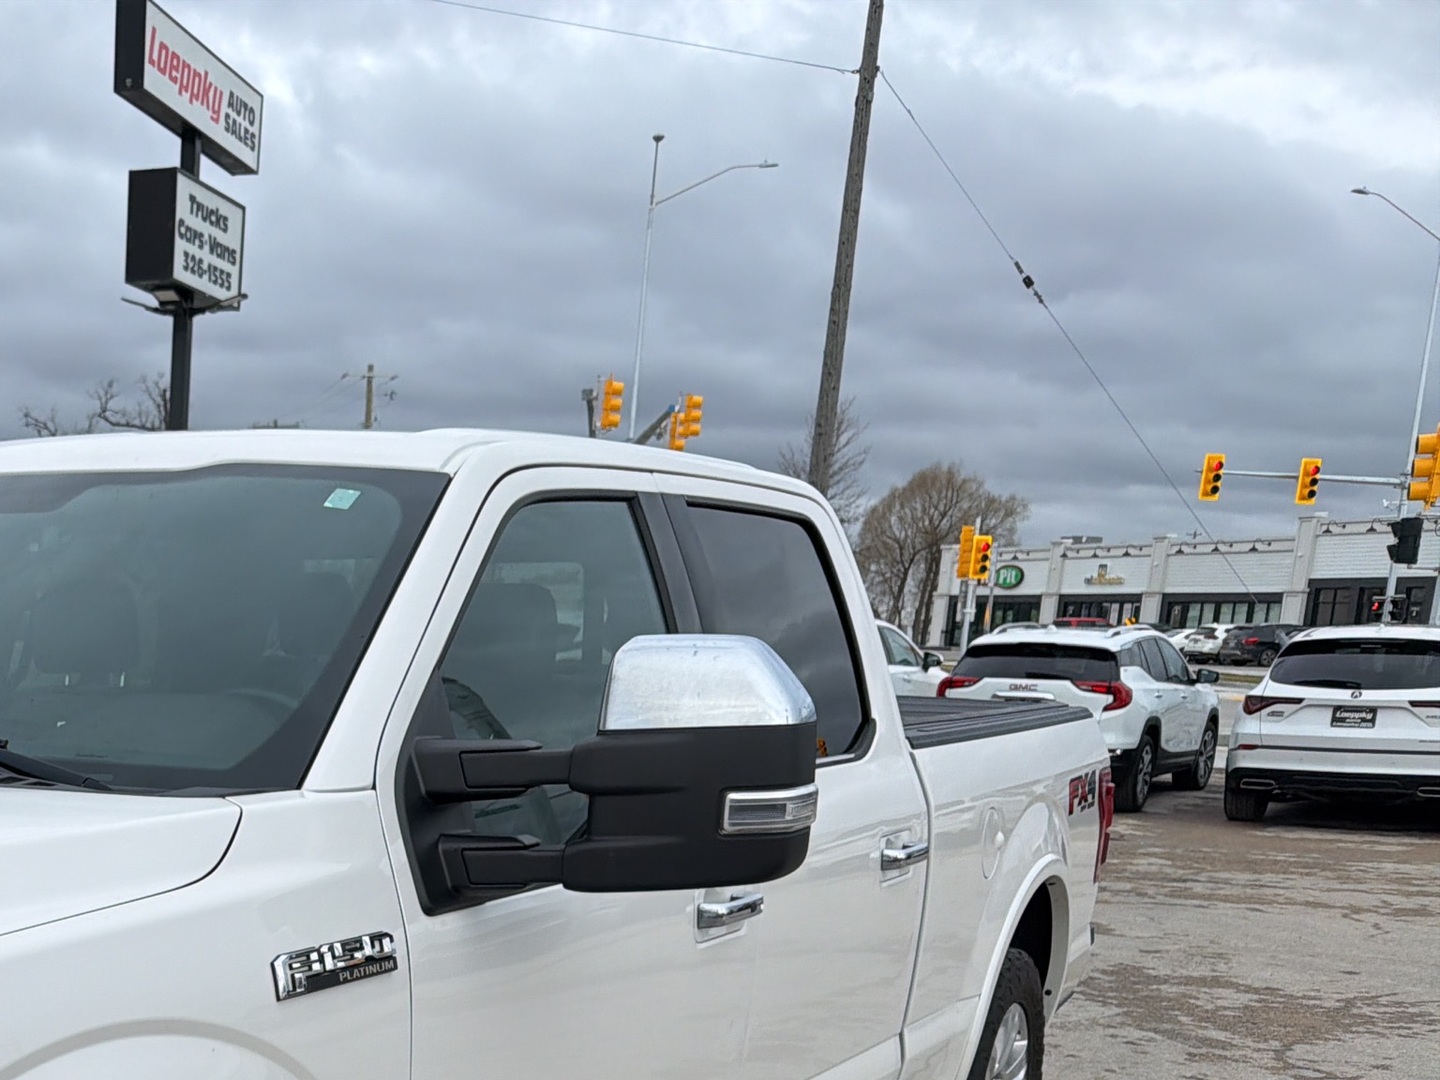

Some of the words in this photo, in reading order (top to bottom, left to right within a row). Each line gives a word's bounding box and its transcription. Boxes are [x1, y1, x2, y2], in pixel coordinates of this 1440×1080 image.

[148, 26, 224, 125] Loeppky
[227, 90, 256, 127] AUTO
[224, 113, 257, 152] SALES
[188, 193, 229, 233] Trucks
[182, 251, 232, 291] 326-1555
[1009, 683, 1038, 691] GMC
[1068, 769, 1096, 816] FX4
[339, 960, 395, 982] PLATINUM
